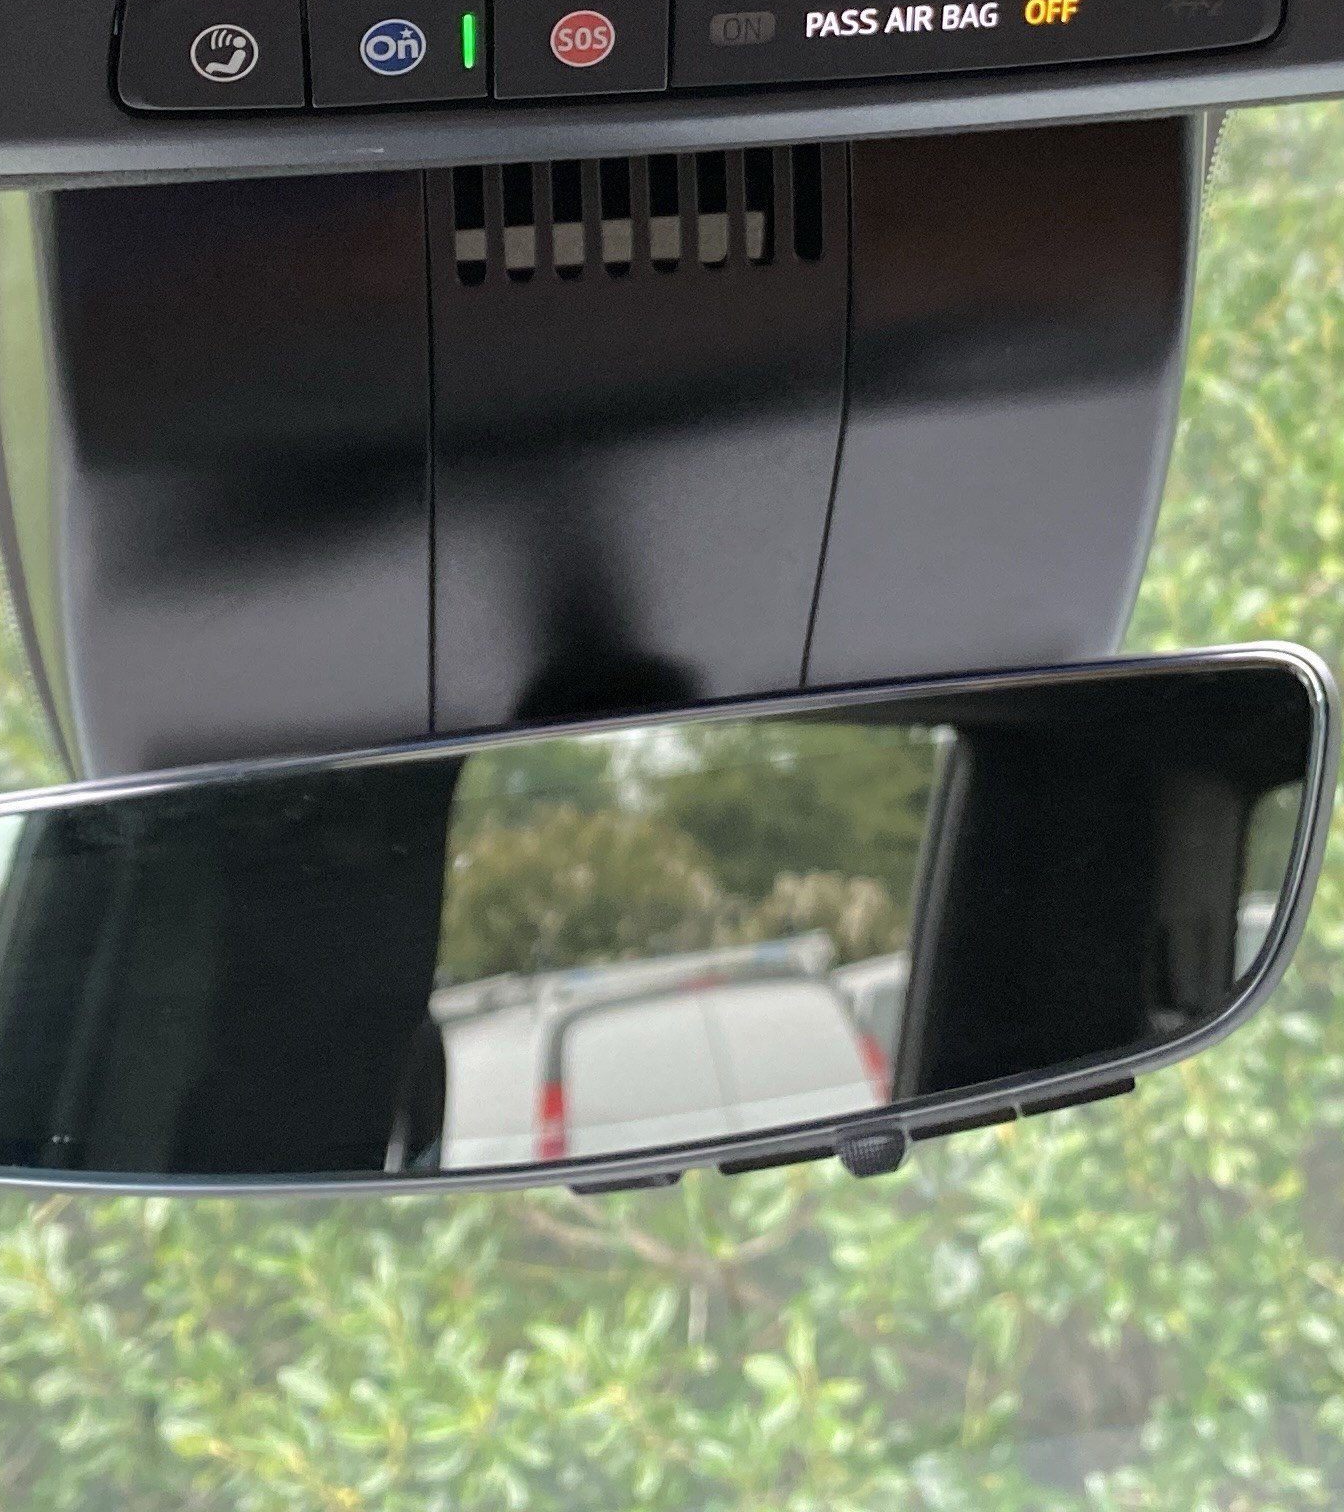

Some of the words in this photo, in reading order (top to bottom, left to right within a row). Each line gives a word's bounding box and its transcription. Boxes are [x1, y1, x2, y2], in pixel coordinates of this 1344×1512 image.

[722, 16, 763, 41] ON
[805, 8, 879, 38] PASS
[883, 5, 934, 34] AIR
[941, 1, 999, 31] BAG
[366, 34, 420, 63] On
[557, 25, 609, 52] SOS
